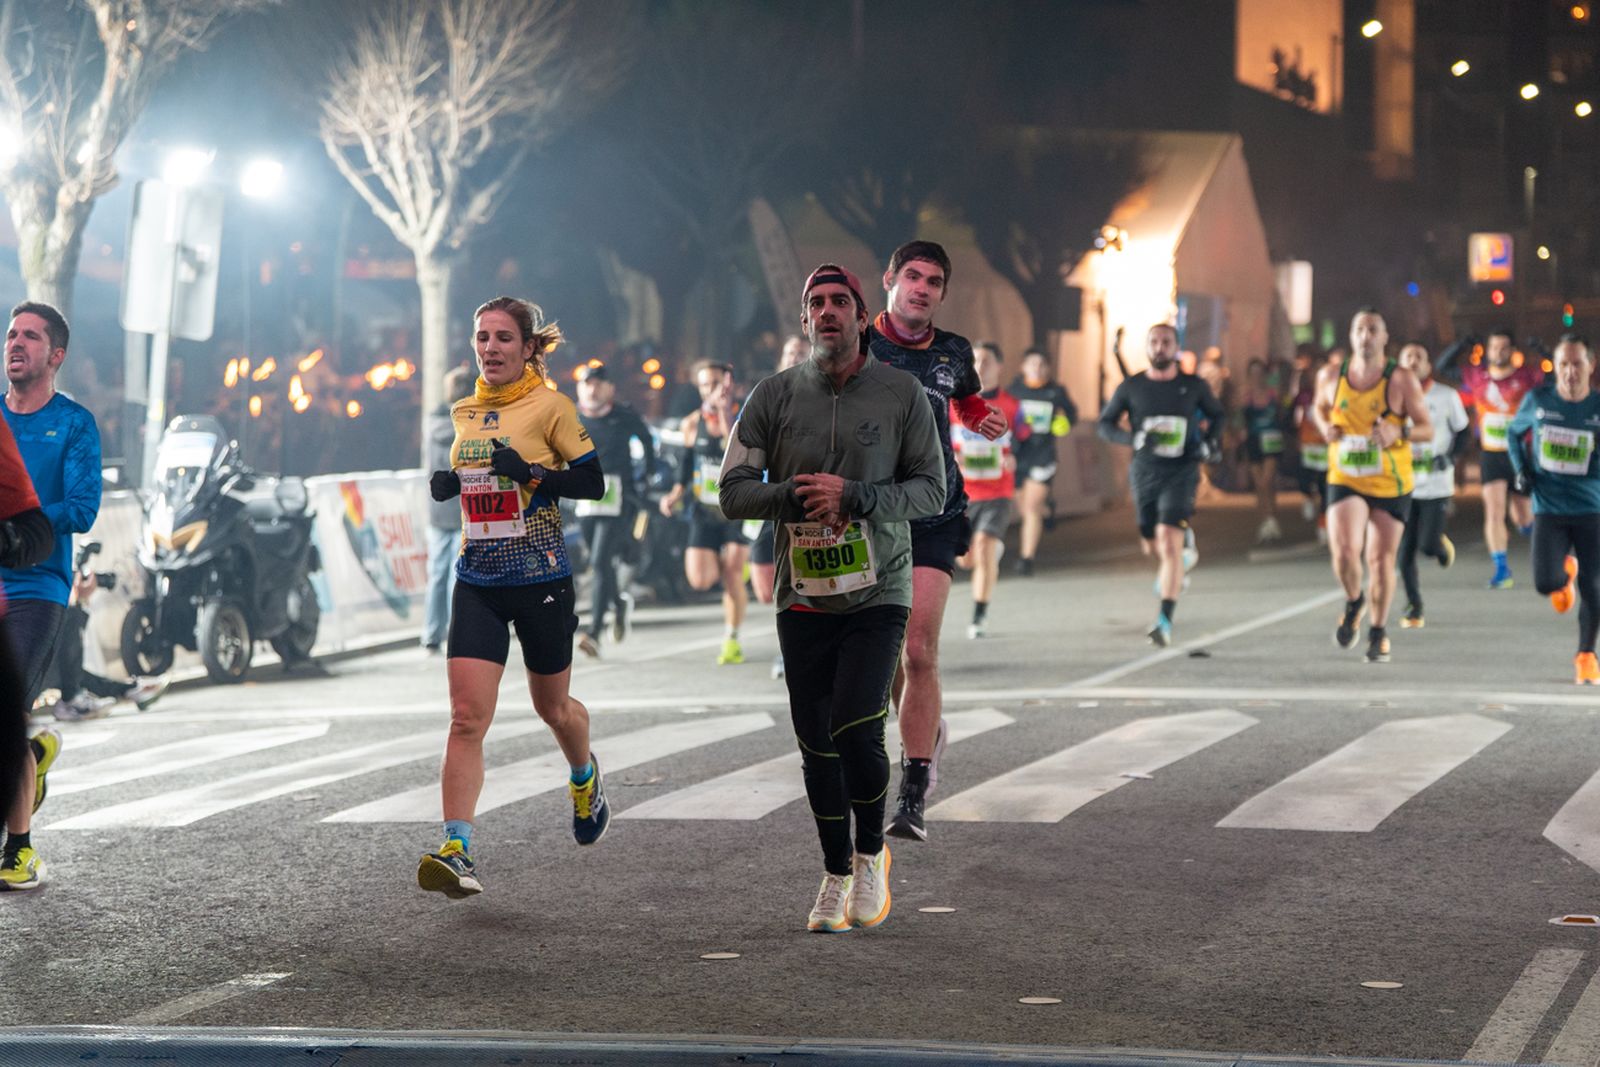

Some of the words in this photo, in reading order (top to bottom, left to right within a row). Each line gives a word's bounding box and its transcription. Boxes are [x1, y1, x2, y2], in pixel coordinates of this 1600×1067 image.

[460, 439, 492, 448] CANILLA
[466, 494, 504, 514] 1102
[803, 544, 855, 570] 1390
